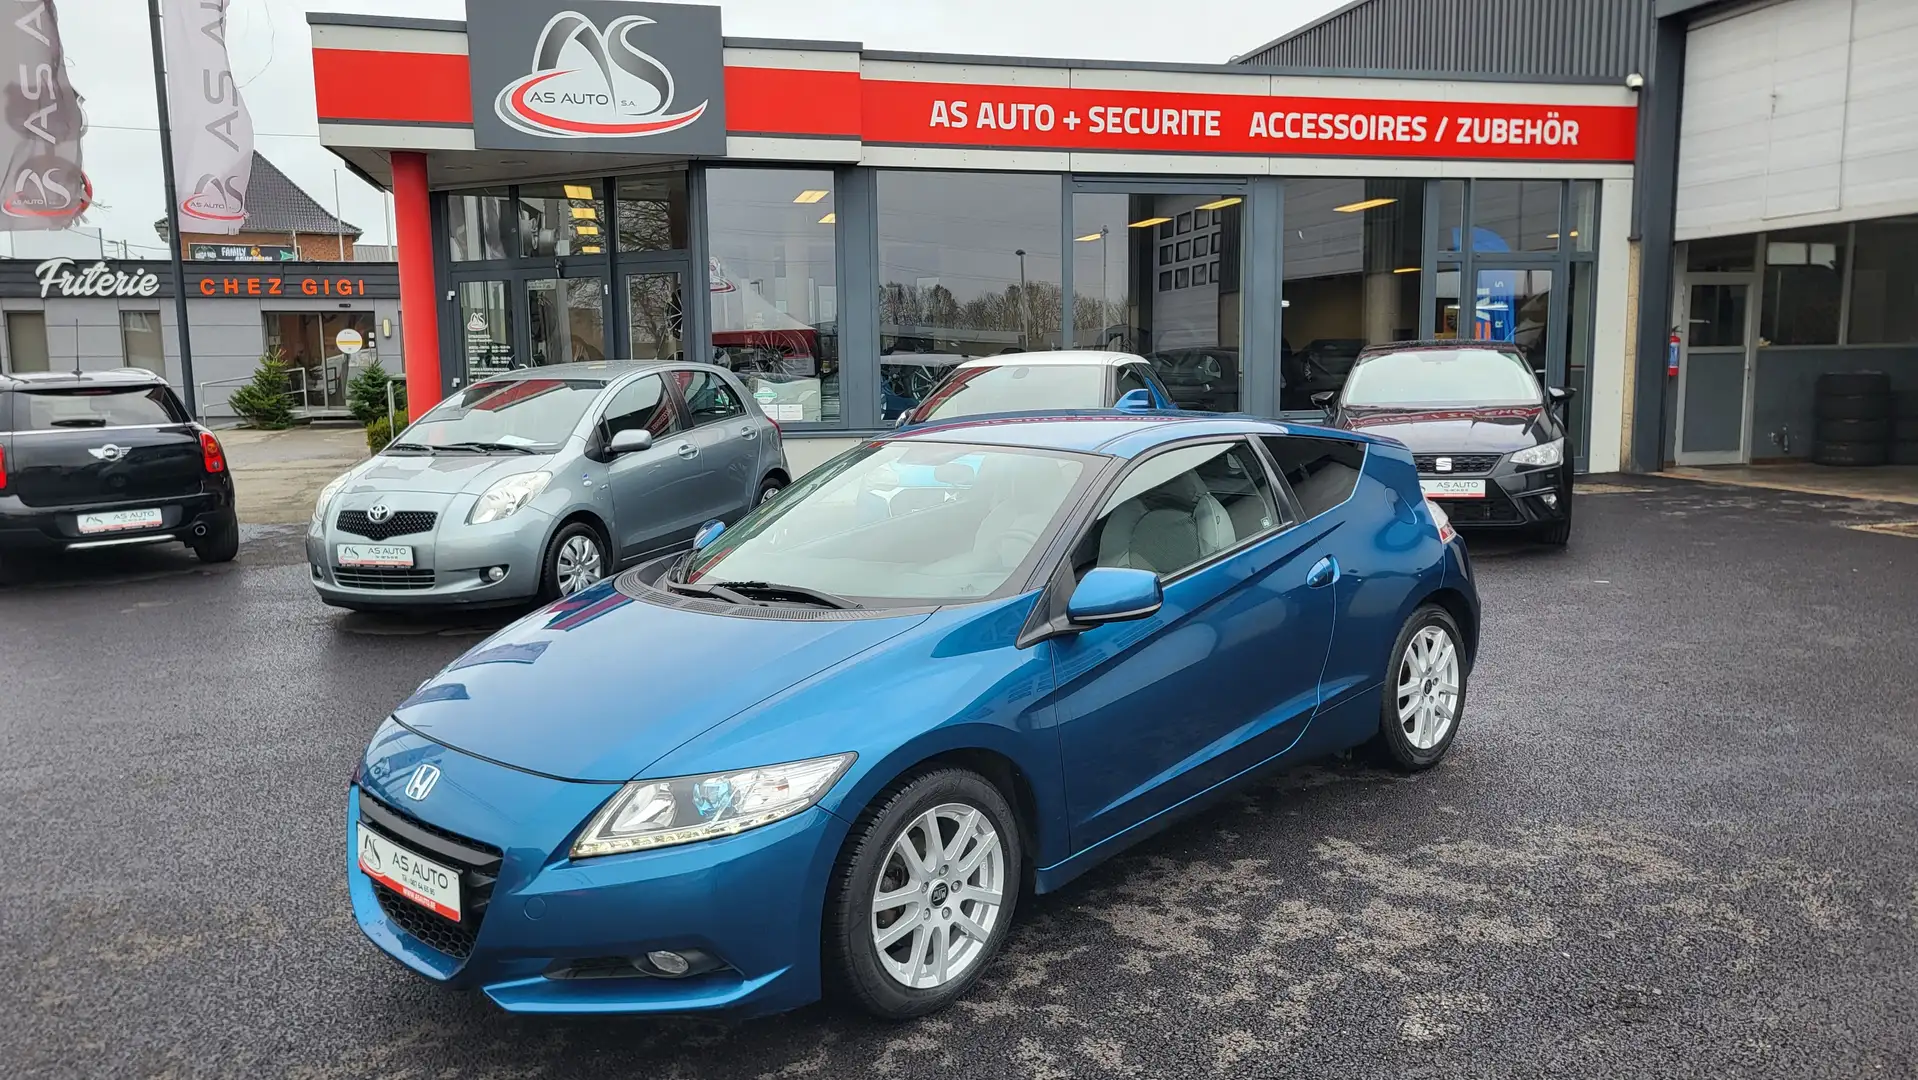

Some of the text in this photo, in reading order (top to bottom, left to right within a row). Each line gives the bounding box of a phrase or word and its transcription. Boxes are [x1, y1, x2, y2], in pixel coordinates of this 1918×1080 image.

[14, 0, 51, 47] A
[529, 91, 556, 103] AS
[560, 93, 609, 105] AUTO
[929, 100, 1221, 137] AS AUTO + SECURITE
[1248, 110, 1581, 145] ACCESSOIRES / ZUBEHÖR
[221, 246, 247, 257] FAMILY
[34, 257, 160, 298] Friterie
[200, 278, 365, 295] CHEZ GIGI
[113, 510, 155, 520] AS AUTO
[368, 547, 406, 555] AS AUTO
[392, 852, 409, 872] AS
[412, 862, 449, 889] AUTO
